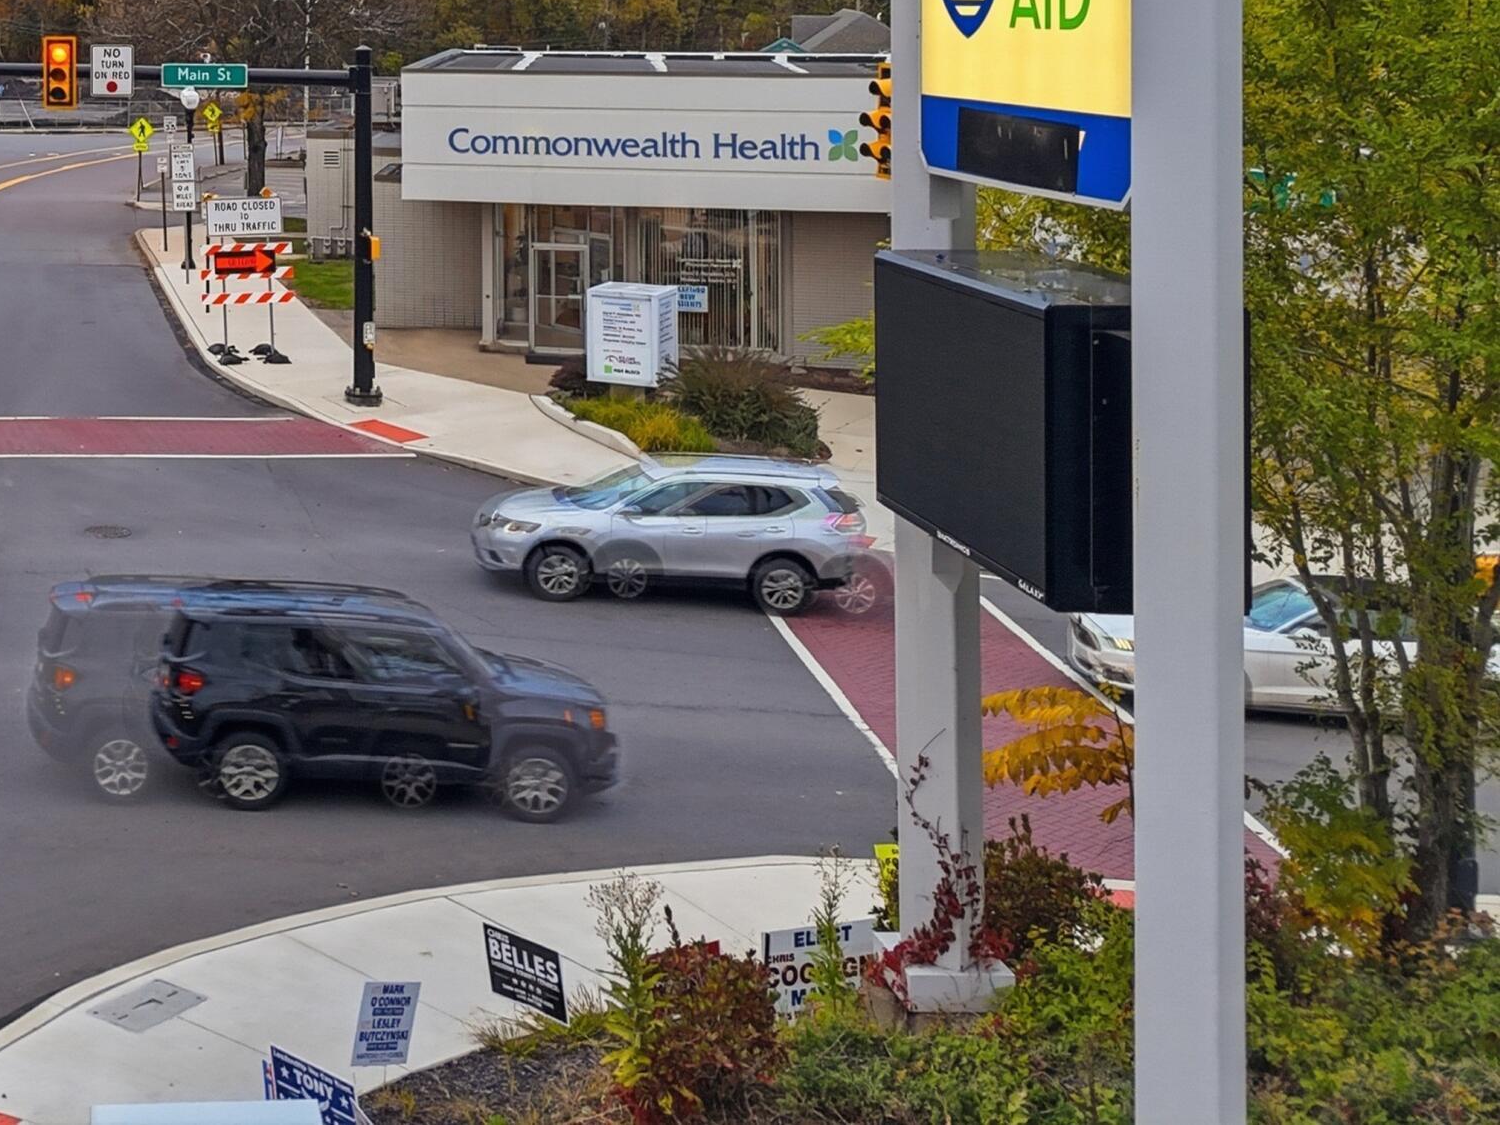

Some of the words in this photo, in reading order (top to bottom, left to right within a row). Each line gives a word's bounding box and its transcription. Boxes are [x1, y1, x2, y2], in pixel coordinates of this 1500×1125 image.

[103, 48, 121, 58] NO
[101, 60, 124, 69] TURN
[94, 71, 107, 80] ON
[112, 71, 130, 80] RED
[177, 67, 209, 81] Main
[217, 67, 231, 81] St
[448, 128, 701, 159] Commonwealth
[713, 133, 820, 161] Health
[214, 202, 237, 211] ROAD
[242, 200, 275, 210] CLOSED
[240, 212, 249, 220] TO
[214, 223, 236, 232] THRU
[242, 221, 276, 231] TRAFFIC
[488, 937, 559, 984] BELLES
[767, 953, 795, 964] CHRIS
[382, 984, 405, 994] MARK
[372, 1018, 401, 1029] LESLEY
[292, 1068, 334, 1100] TONY
